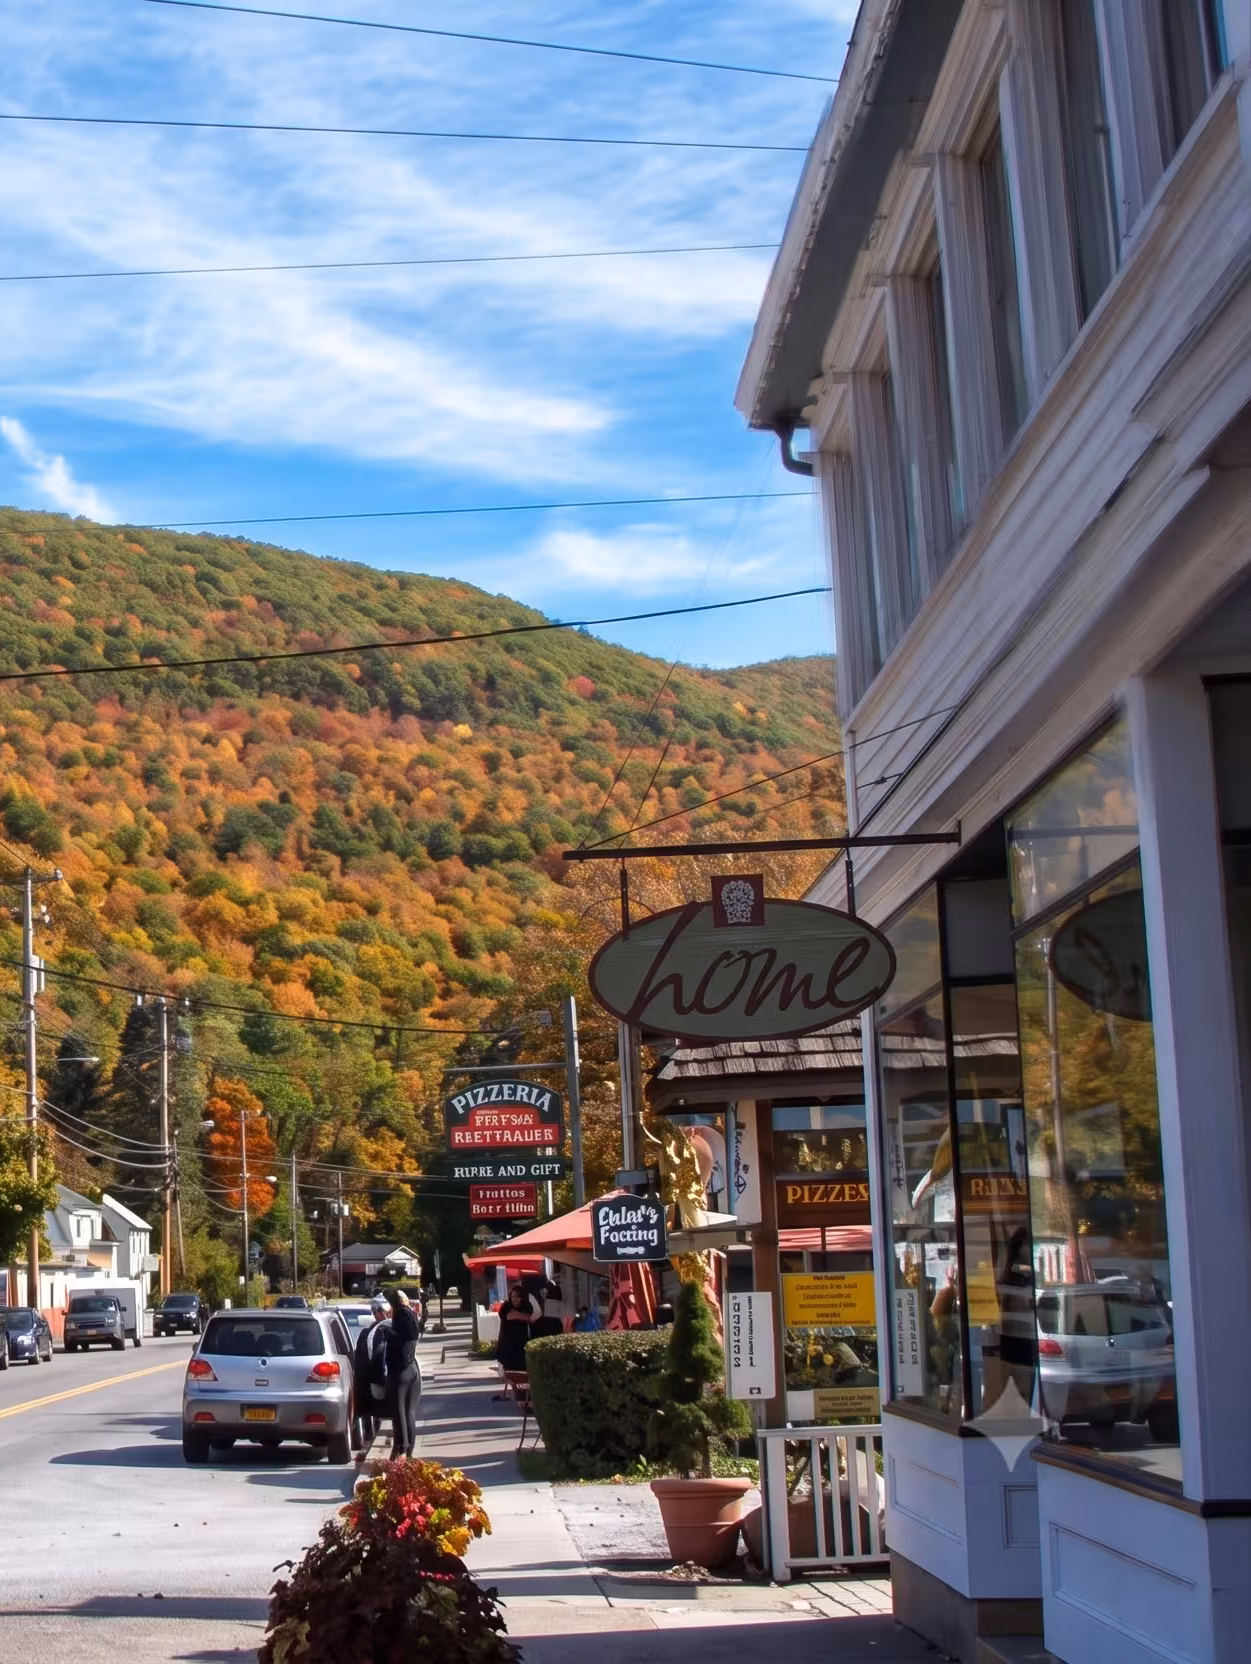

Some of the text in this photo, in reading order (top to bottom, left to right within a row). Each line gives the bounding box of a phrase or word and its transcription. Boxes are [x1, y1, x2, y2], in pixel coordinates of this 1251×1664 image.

[623, 901, 882, 1024] home
[451, 1083, 552, 1115] PIZZERIA
[498, 1165, 526, 1177] AND
